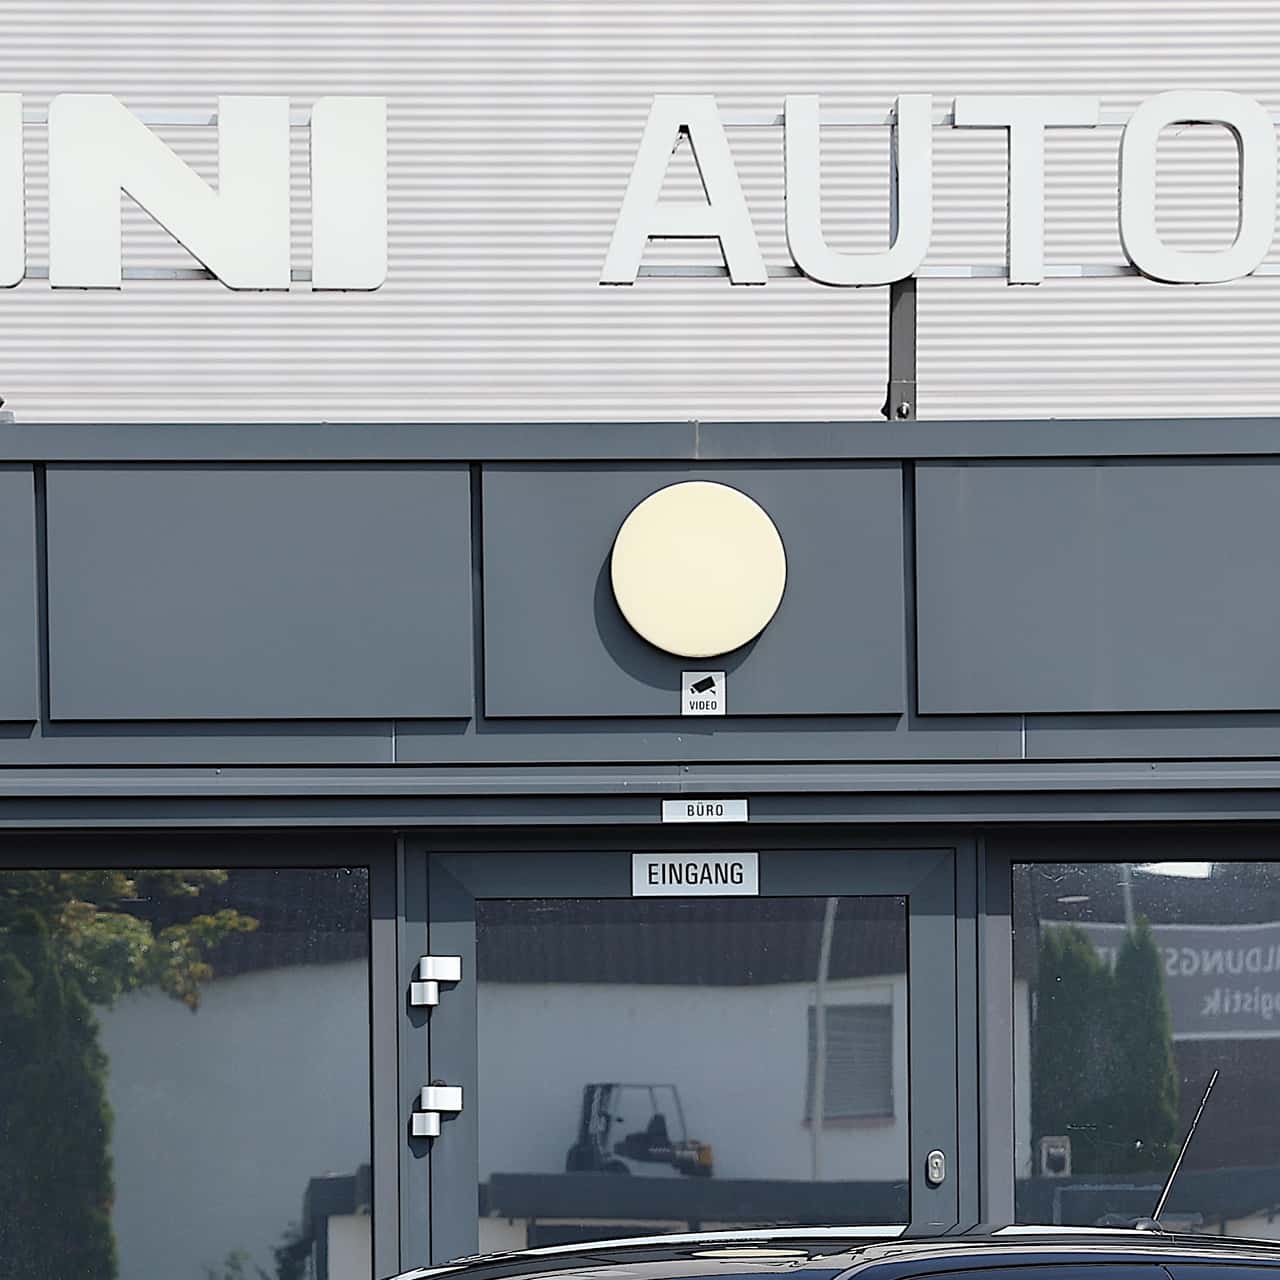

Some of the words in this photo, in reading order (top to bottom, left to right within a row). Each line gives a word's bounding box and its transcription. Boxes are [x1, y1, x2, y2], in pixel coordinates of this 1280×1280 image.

[598, 88, 1279, 286] AUTO
[689, 700, 718, 711] VIDEO
[687, 802, 724, 817] BÜRO
[648, 862, 744, 885] EINGANG
